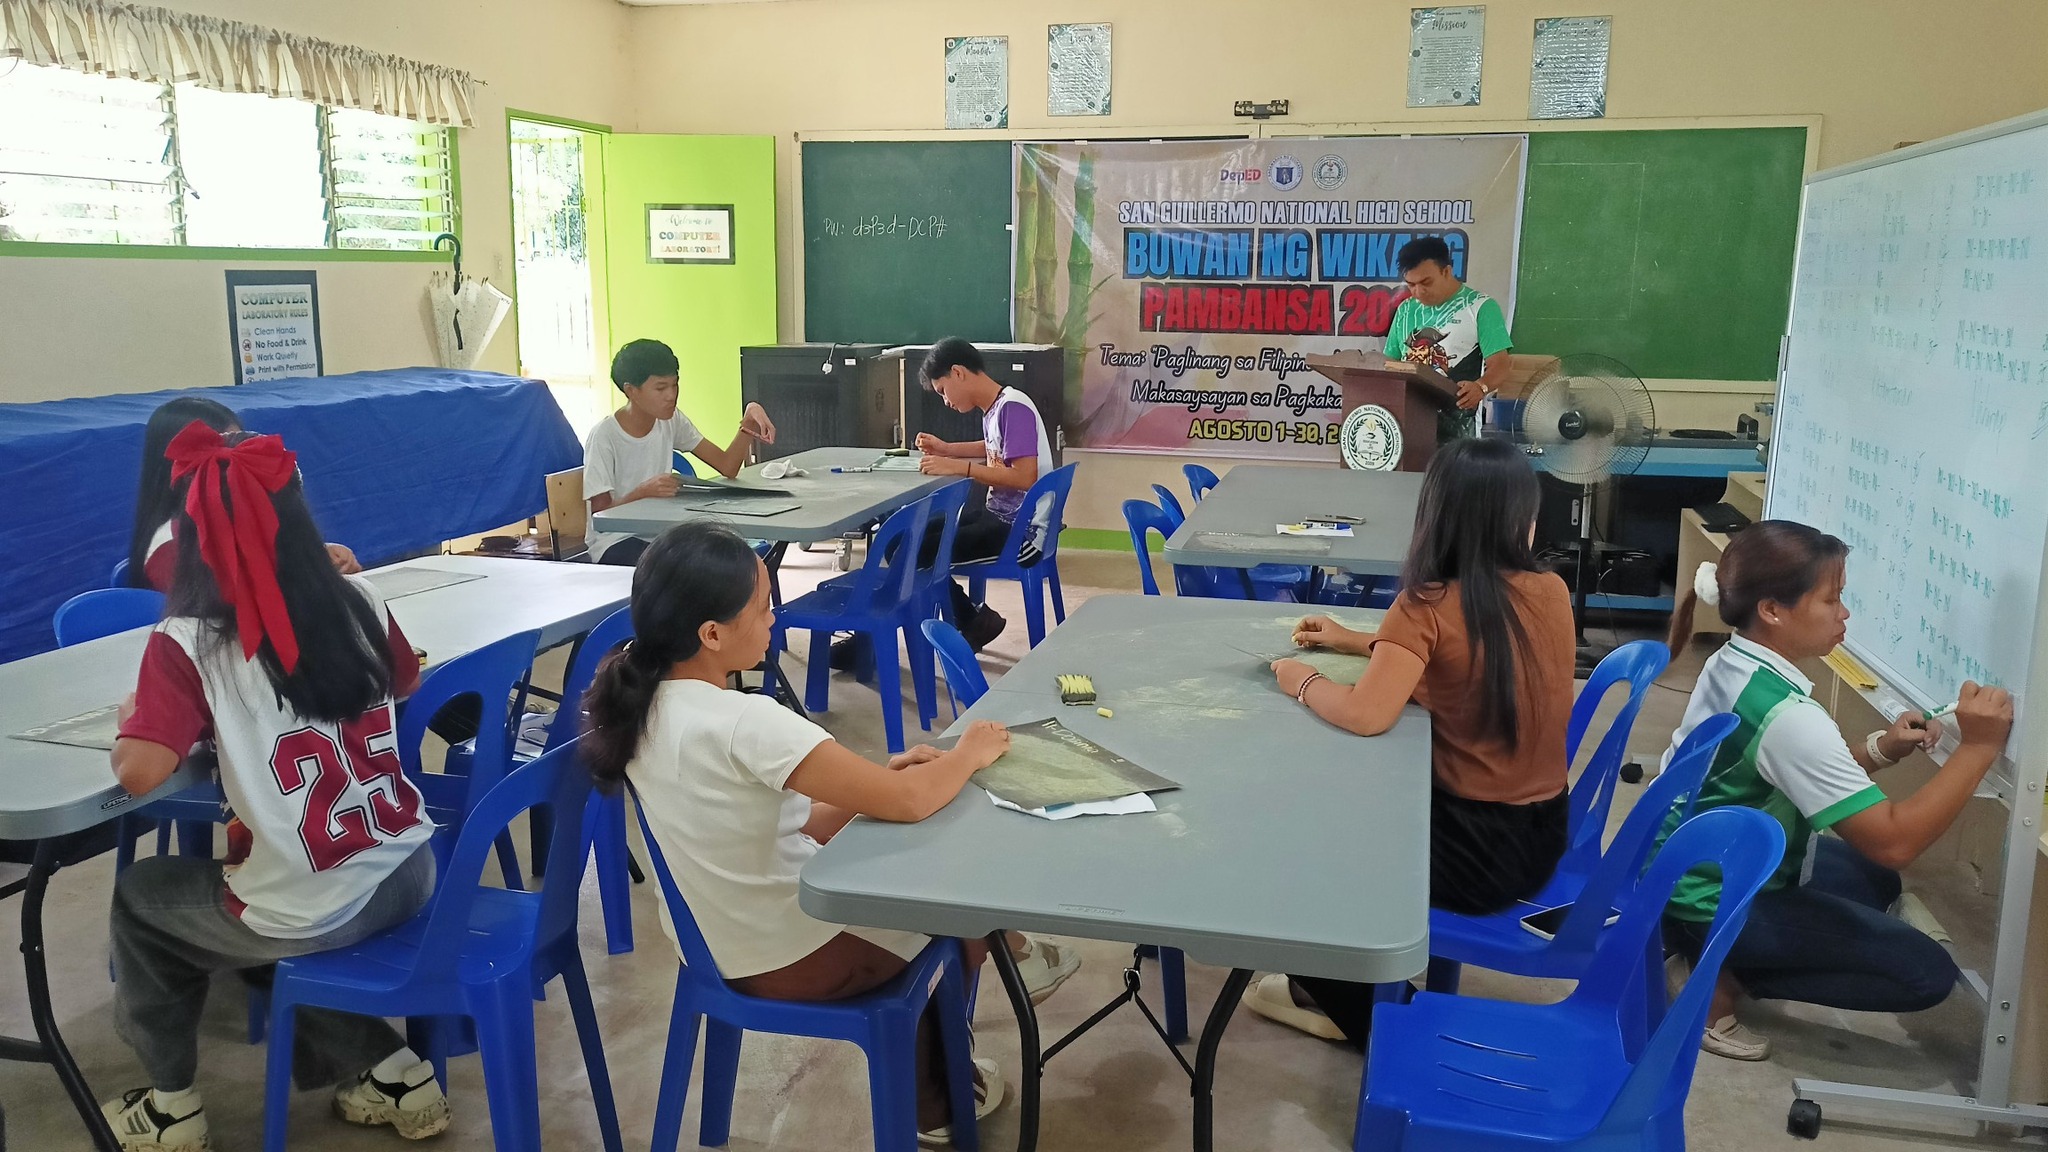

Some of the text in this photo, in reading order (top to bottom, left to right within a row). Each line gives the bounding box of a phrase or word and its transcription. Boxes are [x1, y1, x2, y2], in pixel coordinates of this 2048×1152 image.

[1431, 17, 1468, 31] Mission
[1220, 169, 1261, 185] DepED
[1119, 200, 1475, 224] SAN GUILLERMO NATIONAL HIGH SCHOOL
[659, 231, 722, 241] COMPUTER
[1126, 231, 1467, 279] BUWAN NG WIKG
[241, 291, 308, 305] COMPUTER
[242, 308, 308, 320] LABORATORY RULES
[1142, 285, 1334, 333] PAMBANSA
[254, 325, 296, 336] Clean Hands
[255, 337, 307, 349] No Food & Drink
[257, 351, 298, 361] Work Quietly
[1101, 344, 1146, 366] Tema:
[1236, 354, 1254, 370] sa
[258, 361, 316, 374] Print with Permission
[1131, 380, 1246, 413] Makasaysayan
[1252, 392, 1271, 407] sa
[1363, 407, 1387, 417] NATIONAL
[1387, 416, 1397, 431] HIGH
[1188, 418, 1273, 442] AGOSTO
[1275, 421, 1324, 445] 1-30,
[269, 703, 423, 873] 25
